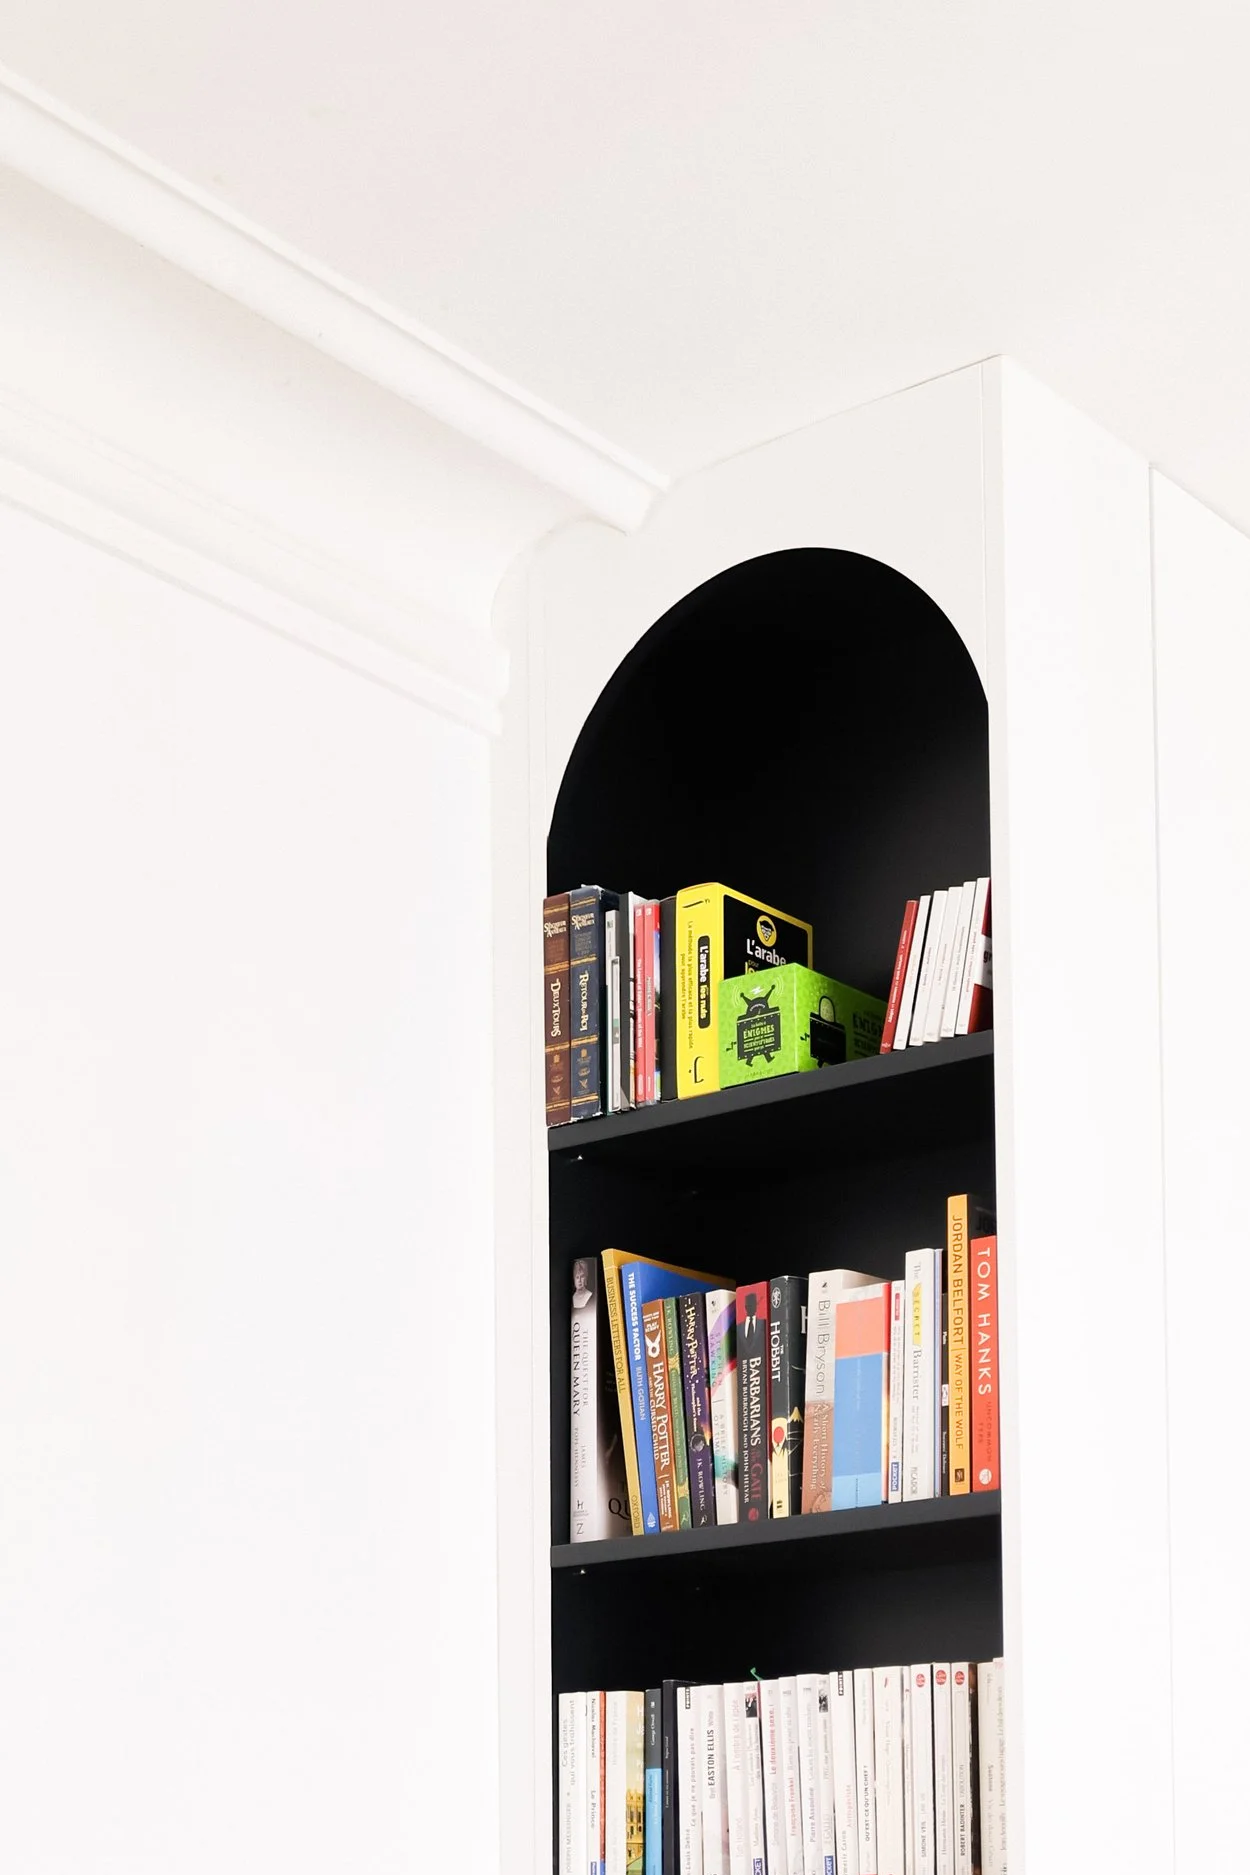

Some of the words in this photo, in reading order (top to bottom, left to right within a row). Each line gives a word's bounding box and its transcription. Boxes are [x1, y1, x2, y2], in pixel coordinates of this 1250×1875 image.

[746, 938, 787, 966] L'arabe
[951, 1215, 963, 1274] JORDAN
[628, 1272, 637, 1290] THE
[913, 1262, 922, 1280] The
[977, 1247, 991, 1301] TOM
[606, 1277, 619, 1318] BUSINESS
[629, 1290, 640, 1327] SUCCESS
[818, 1299, 831, 1327] Bill
[952, 1279, 964, 1344] BELFORT
[611, 1319, 622, 1356] LETTERS
[685, 1306, 697, 1344] HARRY
[572, 1322, 581, 1373] QUEEN
[632, 1328, 641, 1360] FACTOR
[688, 1342, 699, 1379] POTTER
[770, 1321, 781, 1383] HOBBIT
[978, 1313, 992, 1396] HANKS
[615, 1358, 623, 1372] FOR
[635, 1367, 645, 1388] RUTH
[816, 1334, 831, 1395] Bryson
[911, 1349, 923, 1400] Barrister
[954, 1353, 962, 1376] WAY
[572, 1376, 580, 1417] MARY
[617, 1374, 626, 1393] ALL
[652, 1361, 667, 1411] HARRY
[749, 1356, 762, 1447] BARBARIANS
[955, 1379, 962, 1393] OF
[955, 1395, 963, 1416] THE
[656, 1413, 671, 1471] POTTER
[955, 1419, 963, 1450] WOLF
[751, 1462, 763, 1500] GATE
[910, 1467, 918, 1495] PICADOR
[631, 1495, 641, 1529] OXFORD
